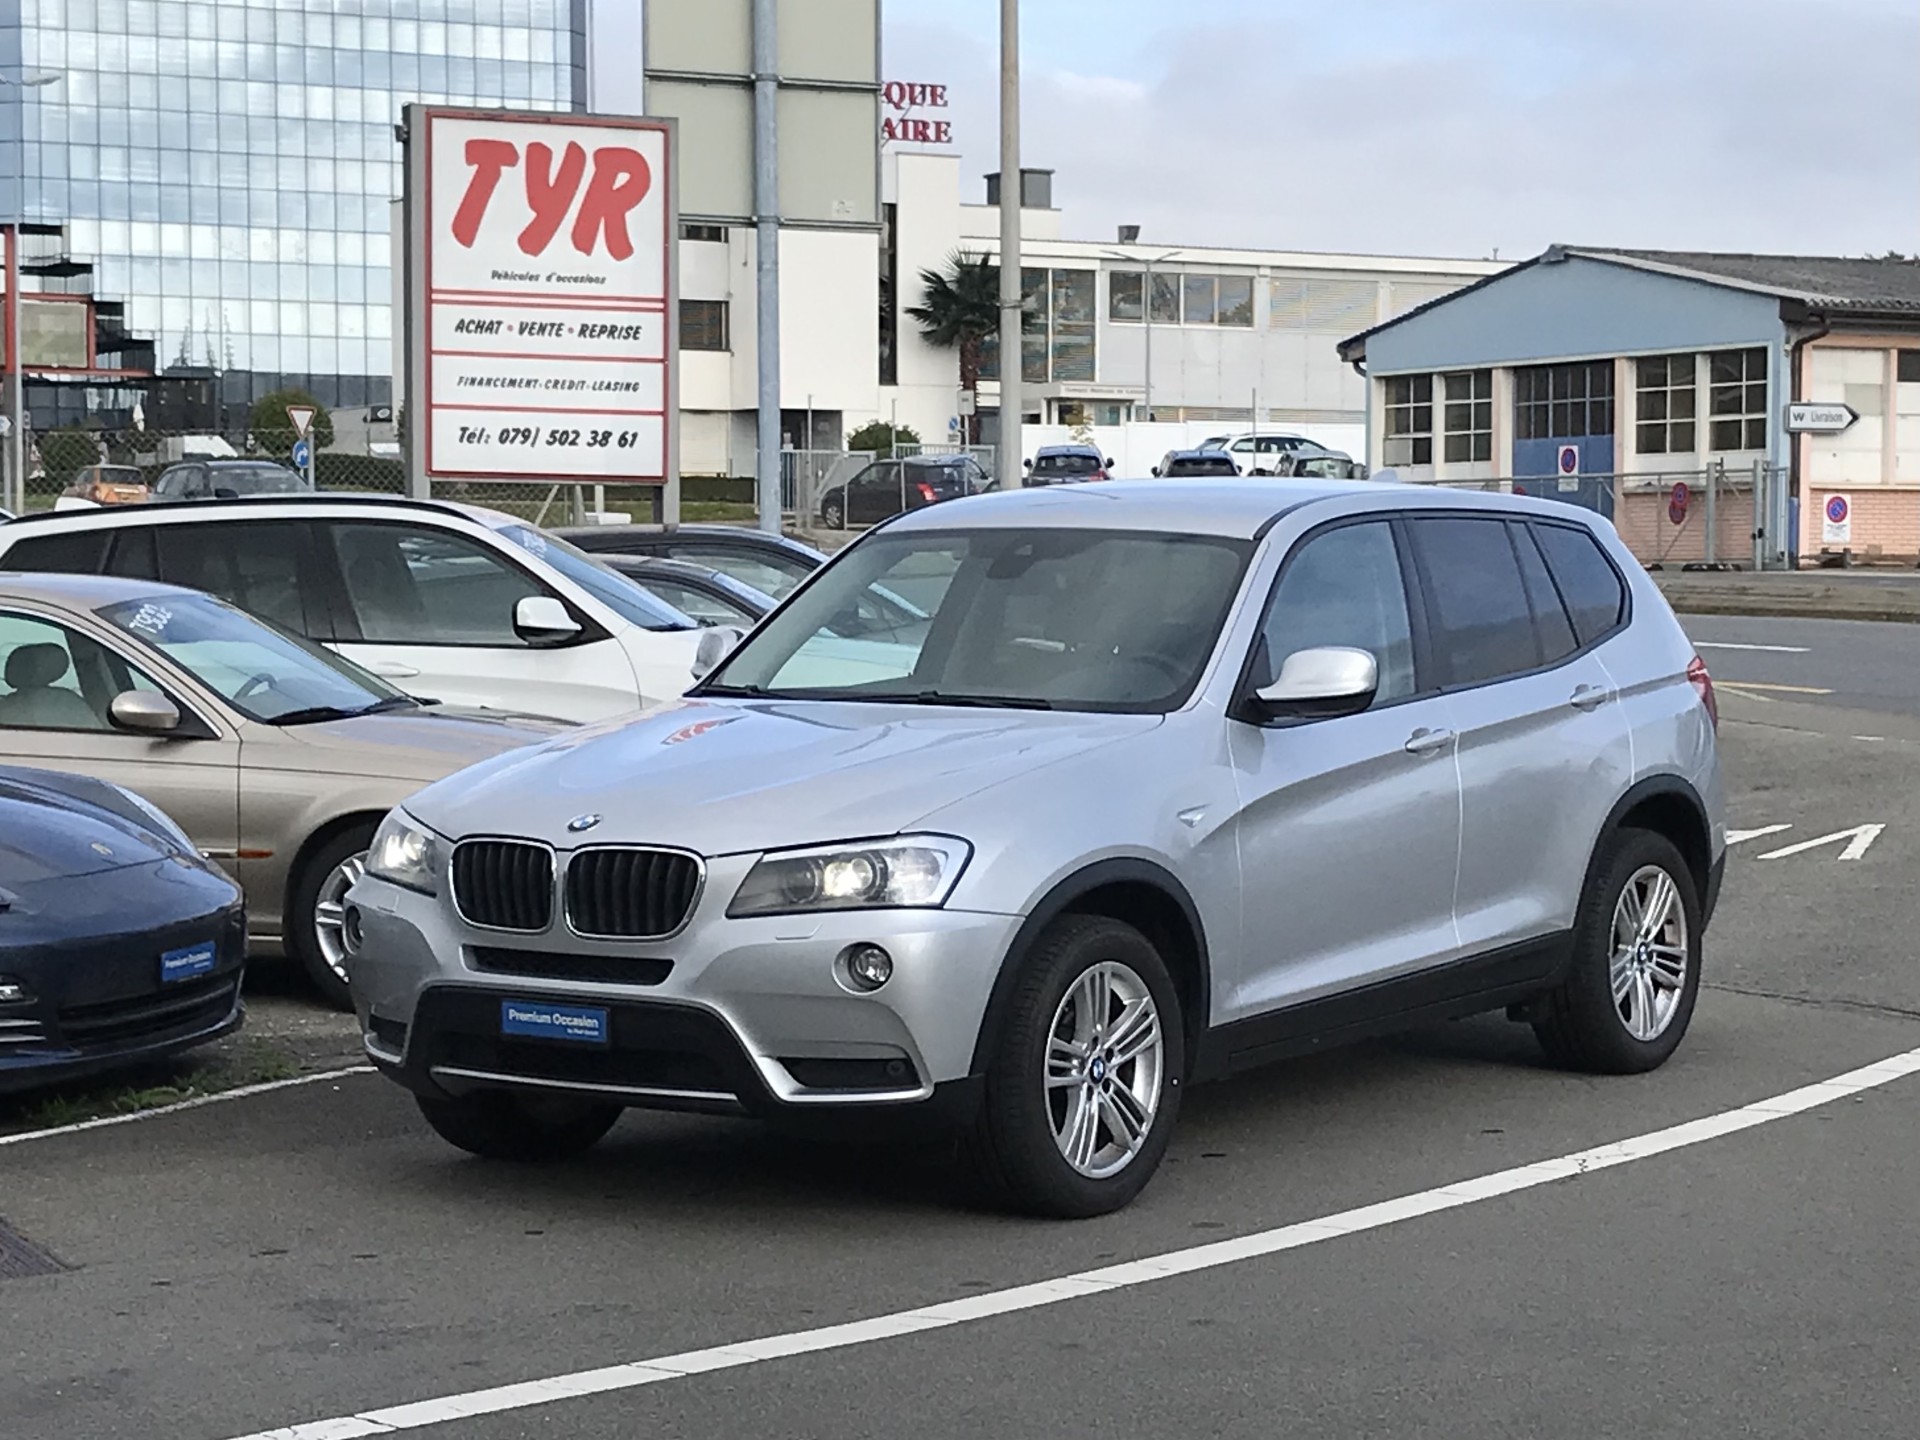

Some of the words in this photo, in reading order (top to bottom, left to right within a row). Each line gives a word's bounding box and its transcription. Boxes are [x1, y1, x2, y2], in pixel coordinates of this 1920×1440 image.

[881, 81, 948, 110] QUE
[452, 139, 651, 262] TYR
[545, 272, 607, 285] d'occasions
[454, 318, 504, 335] ACHAT
[518, 321, 565, 338] VENTE
[577, 323, 643, 341] REPRISE
[546, 429, 581, 447] 502
[586, 430, 613, 448] 38
[617, 431, 639, 449] 61
[508, 1008, 552, 1024] Premium
[552, 1013, 599, 1029] Occasion
